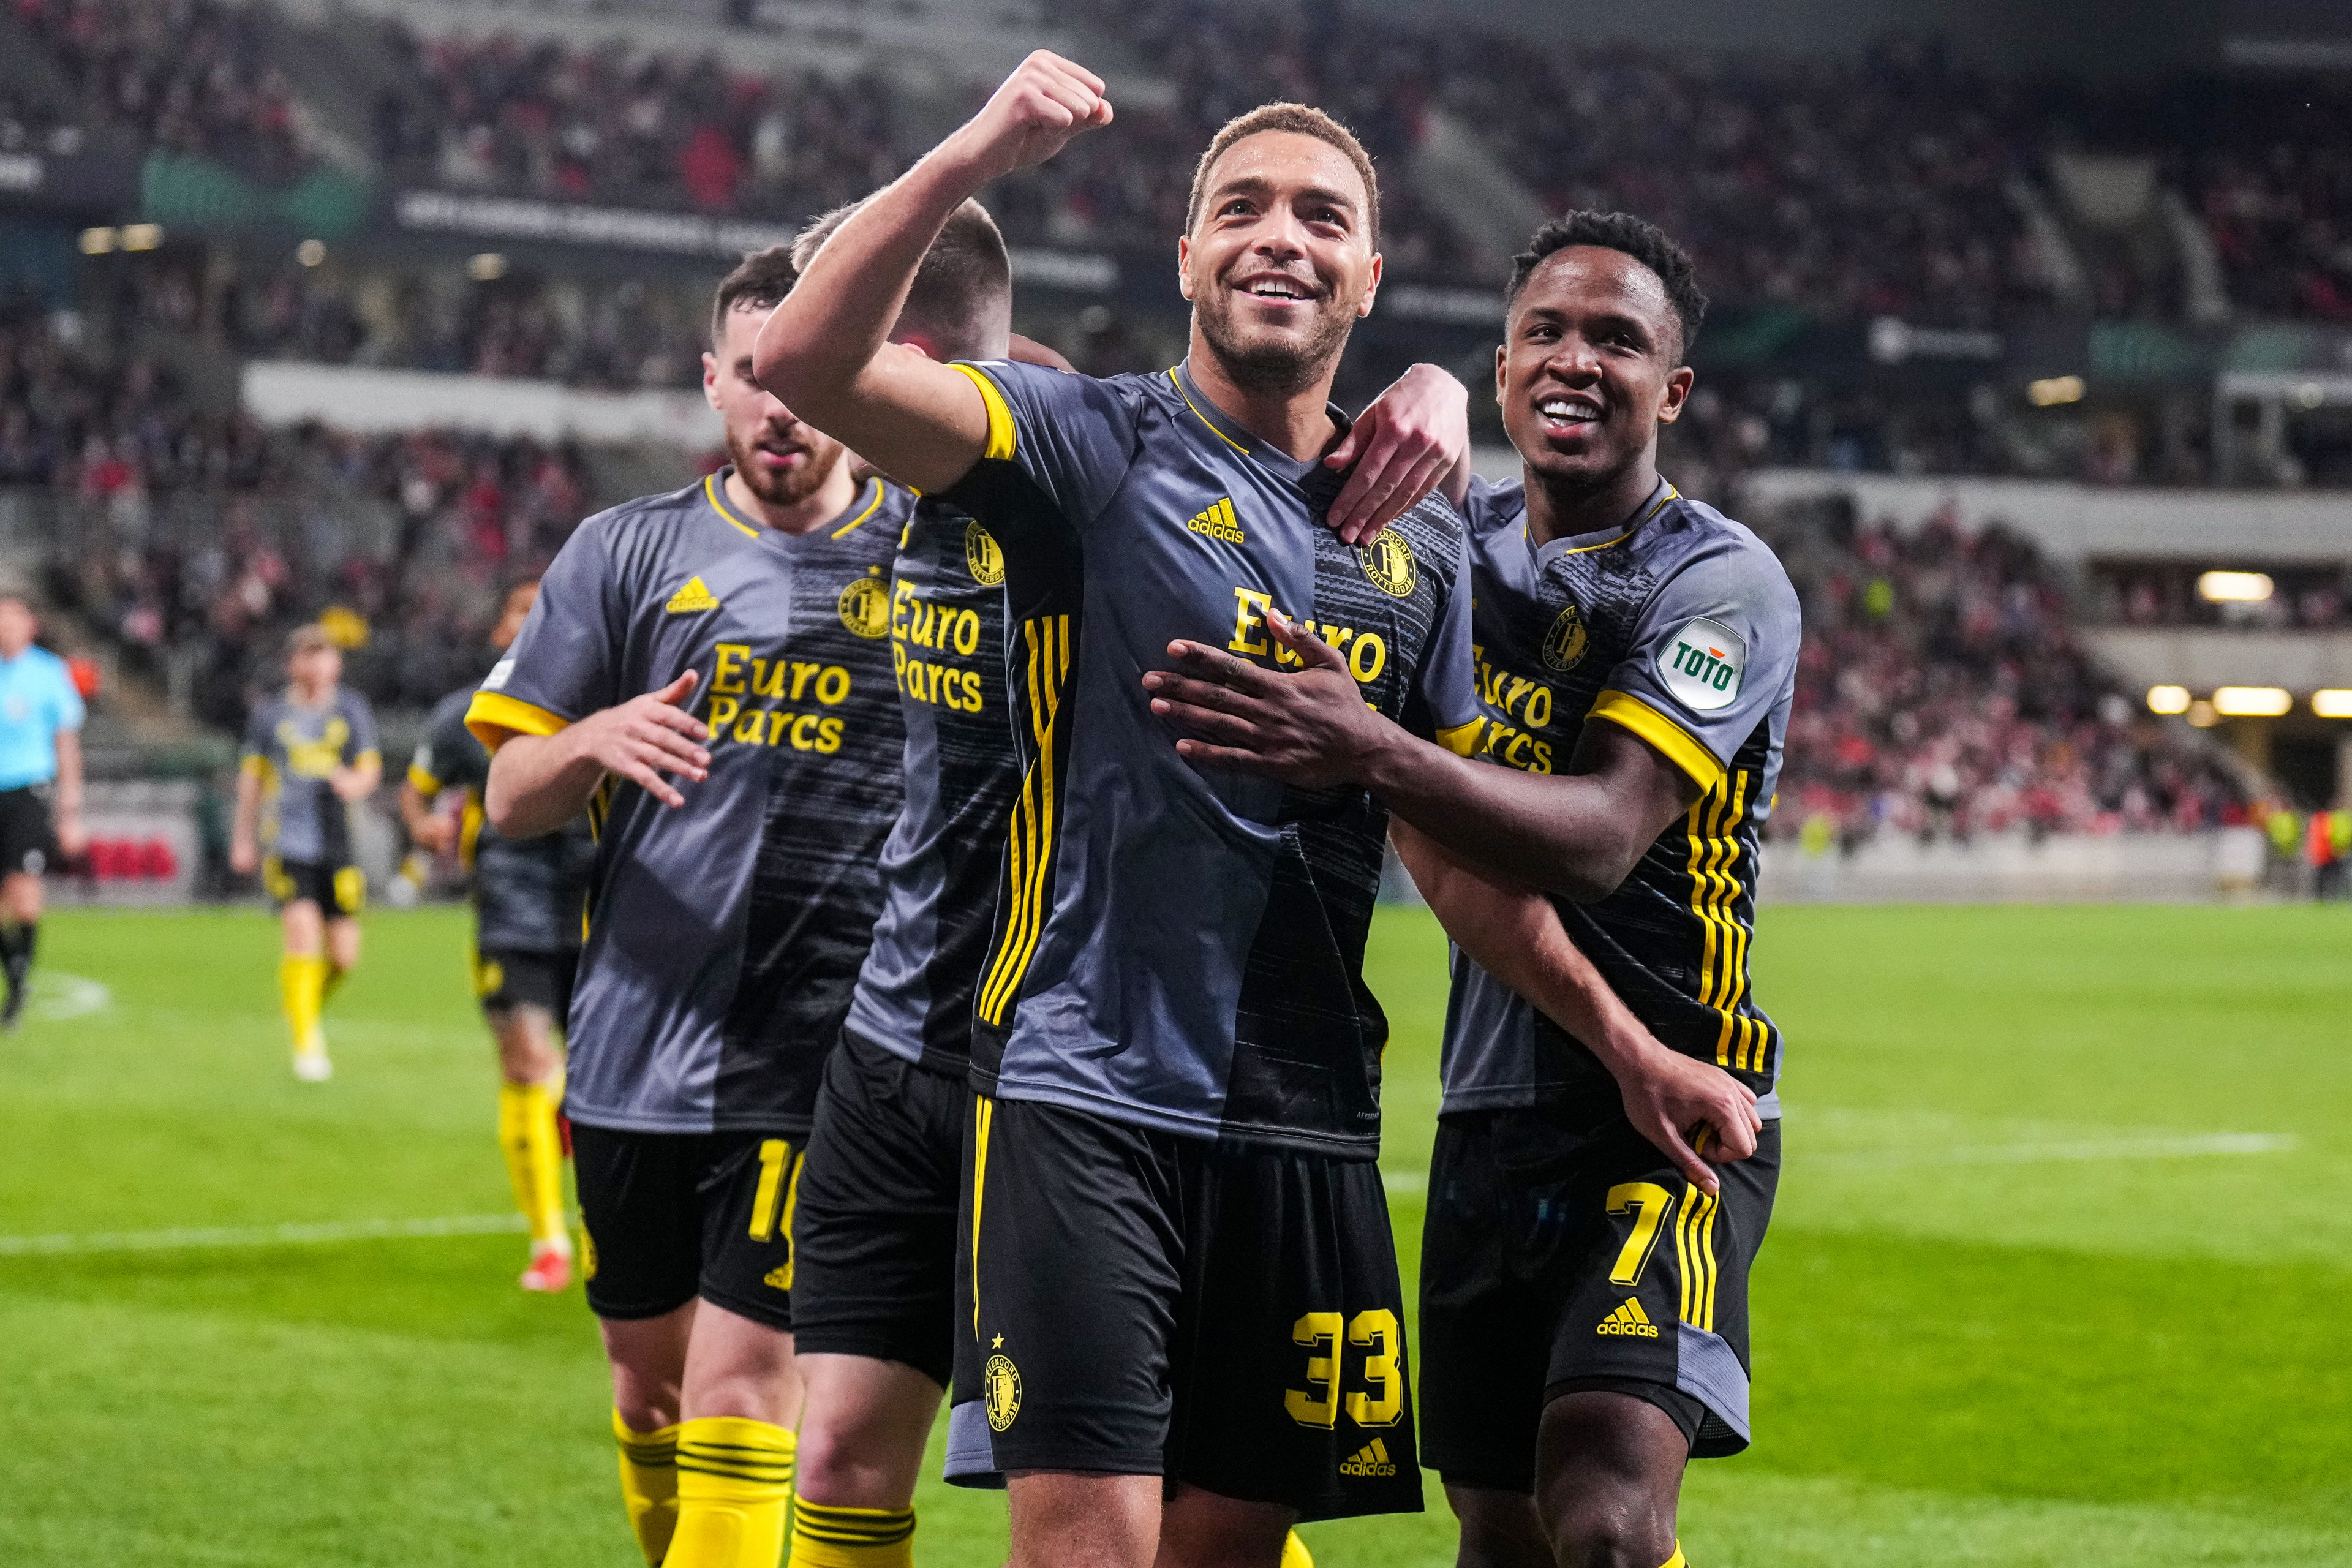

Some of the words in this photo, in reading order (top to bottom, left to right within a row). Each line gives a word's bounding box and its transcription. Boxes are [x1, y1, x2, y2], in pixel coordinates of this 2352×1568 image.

[1188, 519, 1244, 543] adidas
[1368, 530, 1411, 560] ENOORD
[970, 557, 1005, 582] ROTTERDA
[1366, 564, 1413, 594] ROTTERDAM
[892, 579, 980, 656] Euro
[711, 643, 851, 705] Euro
[892, 641, 983, 713] Parcs
[1673, 641, 1733, 692] TOTO
[708, 695, 845, 754] Parcs
[1480, 715, 1552, 775] rcs
[748, 1139, 805, 1243] 1
[1606, 1182, 1675, 1286] 7
[1597, 1321, 1658, 1338] adidas
[987, 1357, 1017, 1384] FEYENOORD
[1284, 1308, 1403, 1430] 33
[988, 1401, 1018, 1428] ROTTERDAM
[1339, 1461, 1396, 1476] adidas
